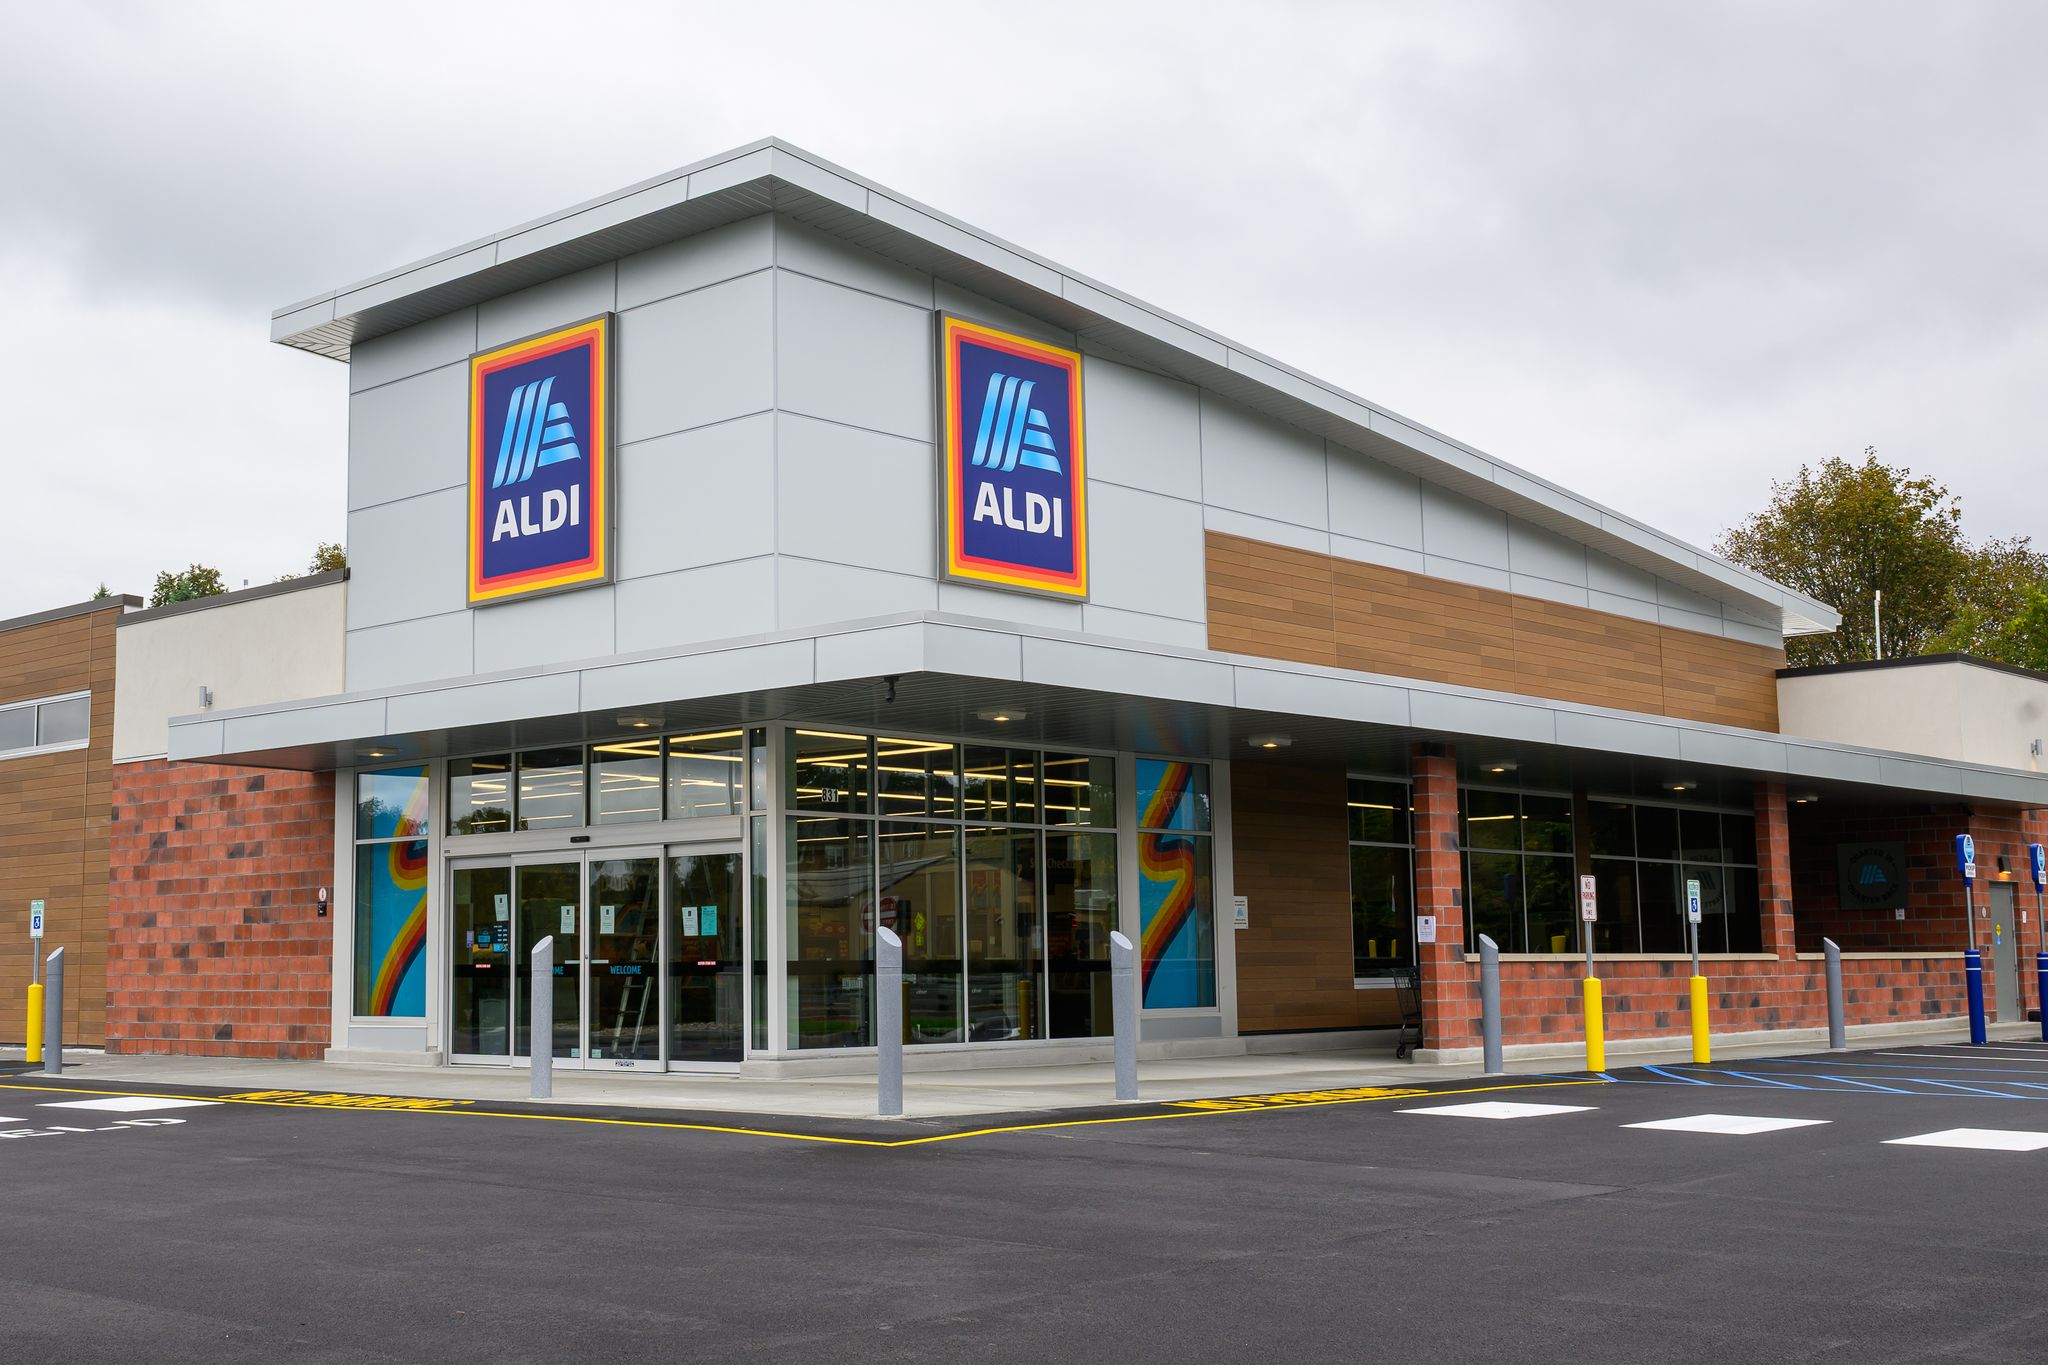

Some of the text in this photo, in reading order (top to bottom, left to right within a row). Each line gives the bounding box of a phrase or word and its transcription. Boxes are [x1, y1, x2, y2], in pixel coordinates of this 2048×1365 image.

[491, 483, 580, 543] ALDI
[973, 481, 1063, 538] ALDI
[822, 788, 838, 802] 831
[609, 965, 642, 975] WELCOME
